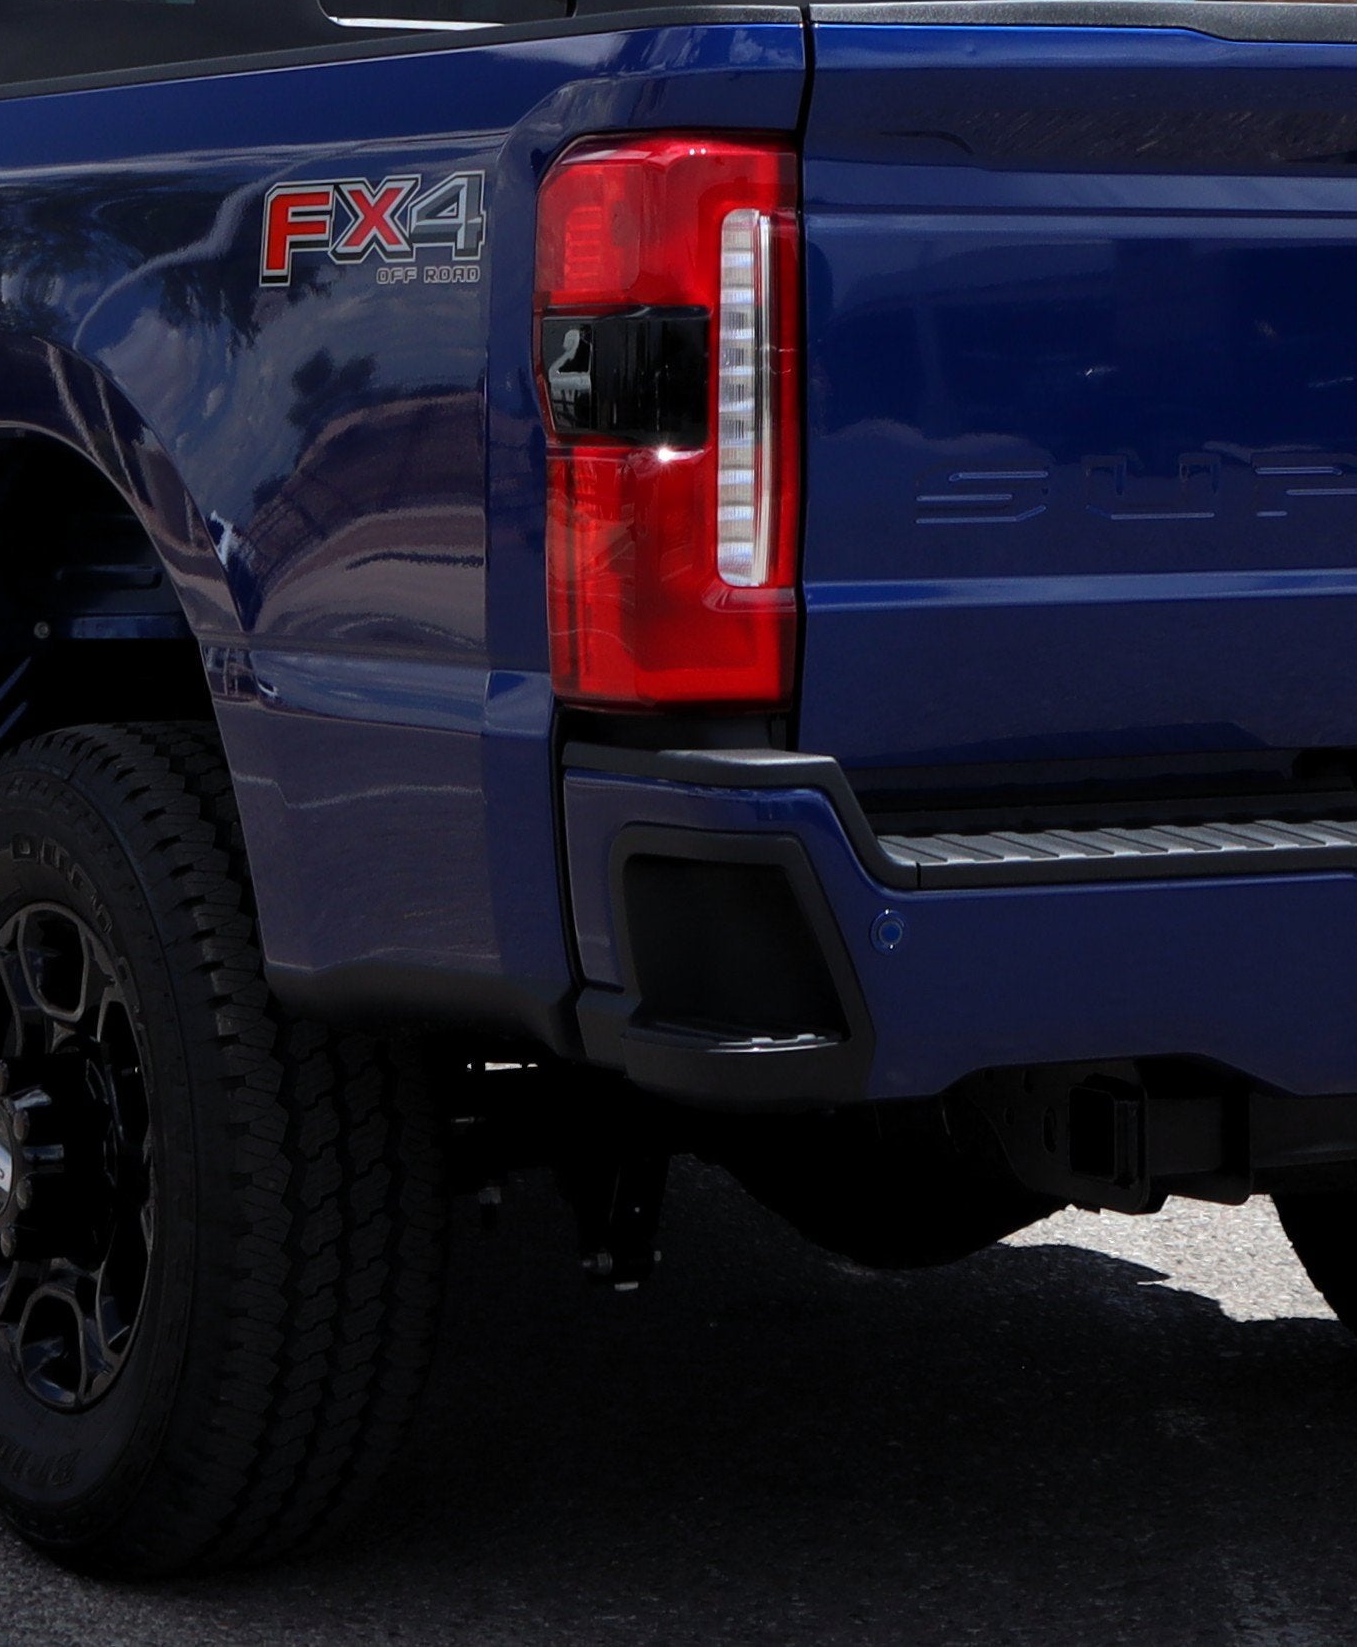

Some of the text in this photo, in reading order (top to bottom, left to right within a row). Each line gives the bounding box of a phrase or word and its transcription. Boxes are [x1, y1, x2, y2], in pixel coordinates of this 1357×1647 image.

[259, 169, 487, 288] FX4
[376, 265, 481, 285] OFF ROAD
